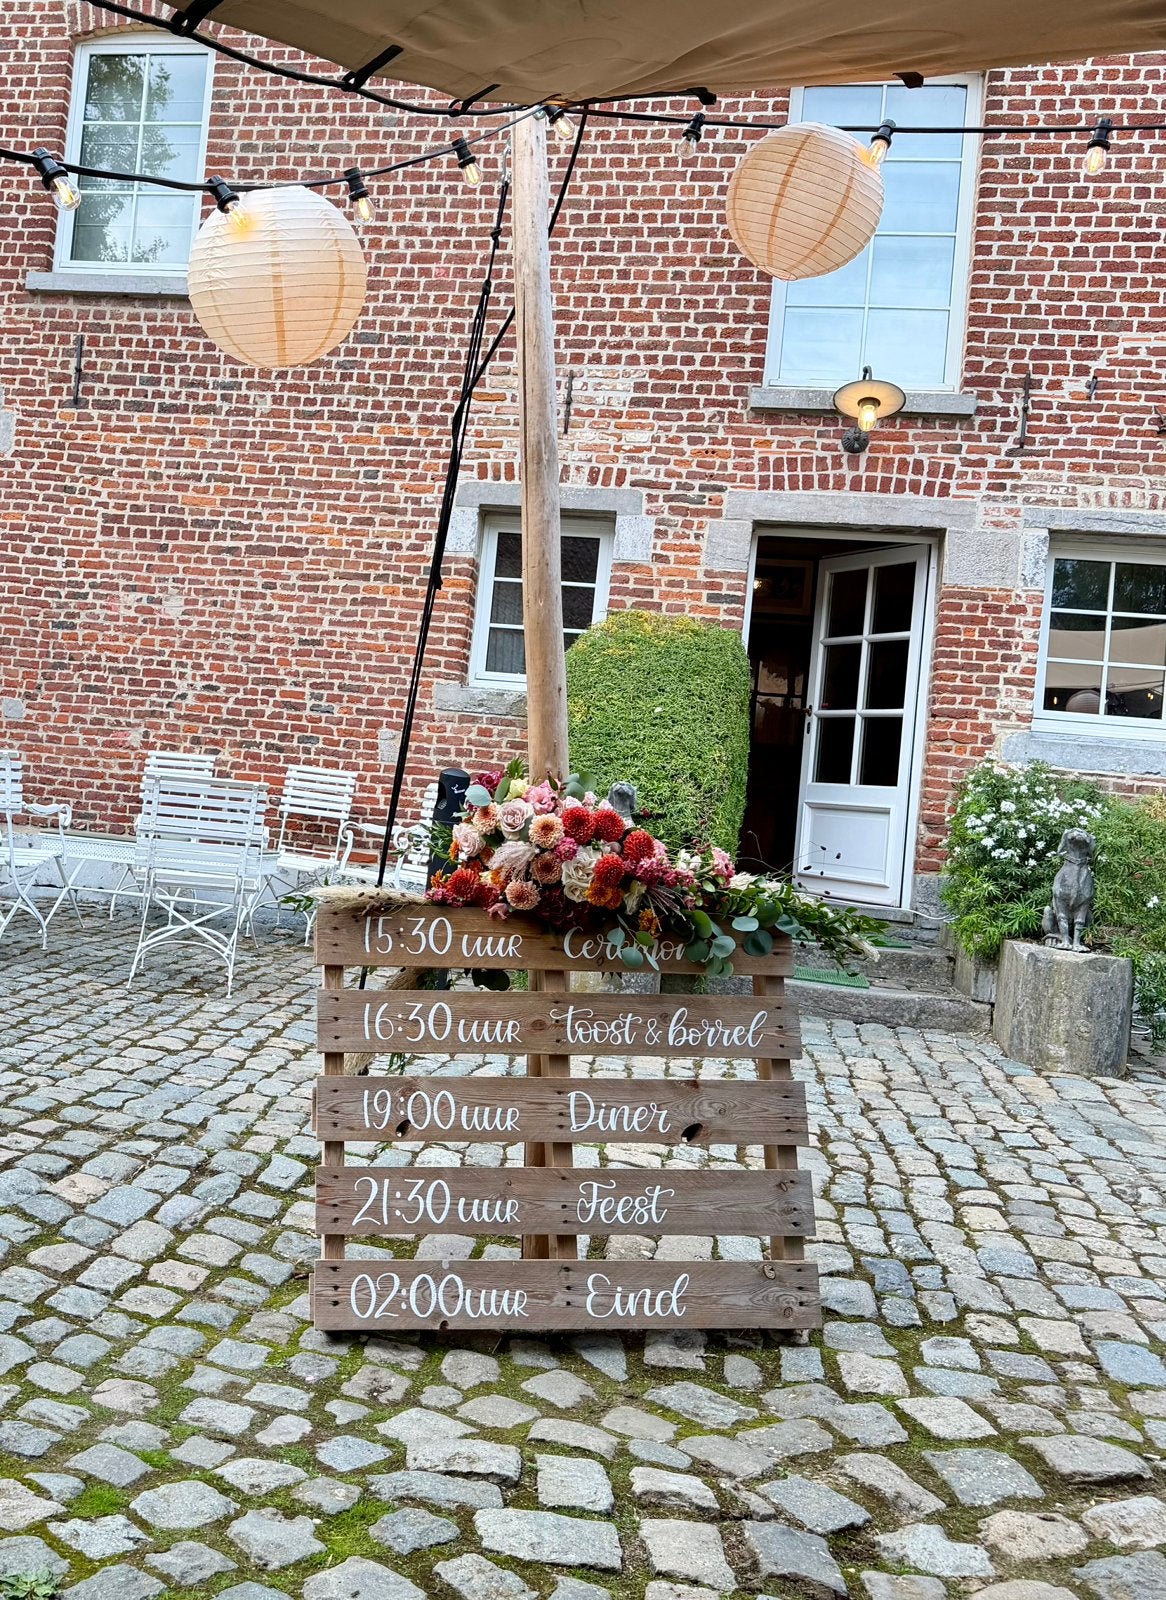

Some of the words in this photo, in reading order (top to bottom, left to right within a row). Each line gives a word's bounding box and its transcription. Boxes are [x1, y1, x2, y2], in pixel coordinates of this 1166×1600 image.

[363, 916, 453, 955] 15:30
[363, 1002, 453, 1042] 16:30
[549, 1005, 643, 1045] toost
[644, 1018, 663, 1045] &
[667, 1007, 768, 1048] borrel
[363, 1089, 456, 1130] 19:00
[567, 1090, 672, 1133] Diner
[351, 1176, 451, 1227] 21:30
[576, 1179, 675, 1225] Feest
[586, 1273, 690, 1318] Eind
